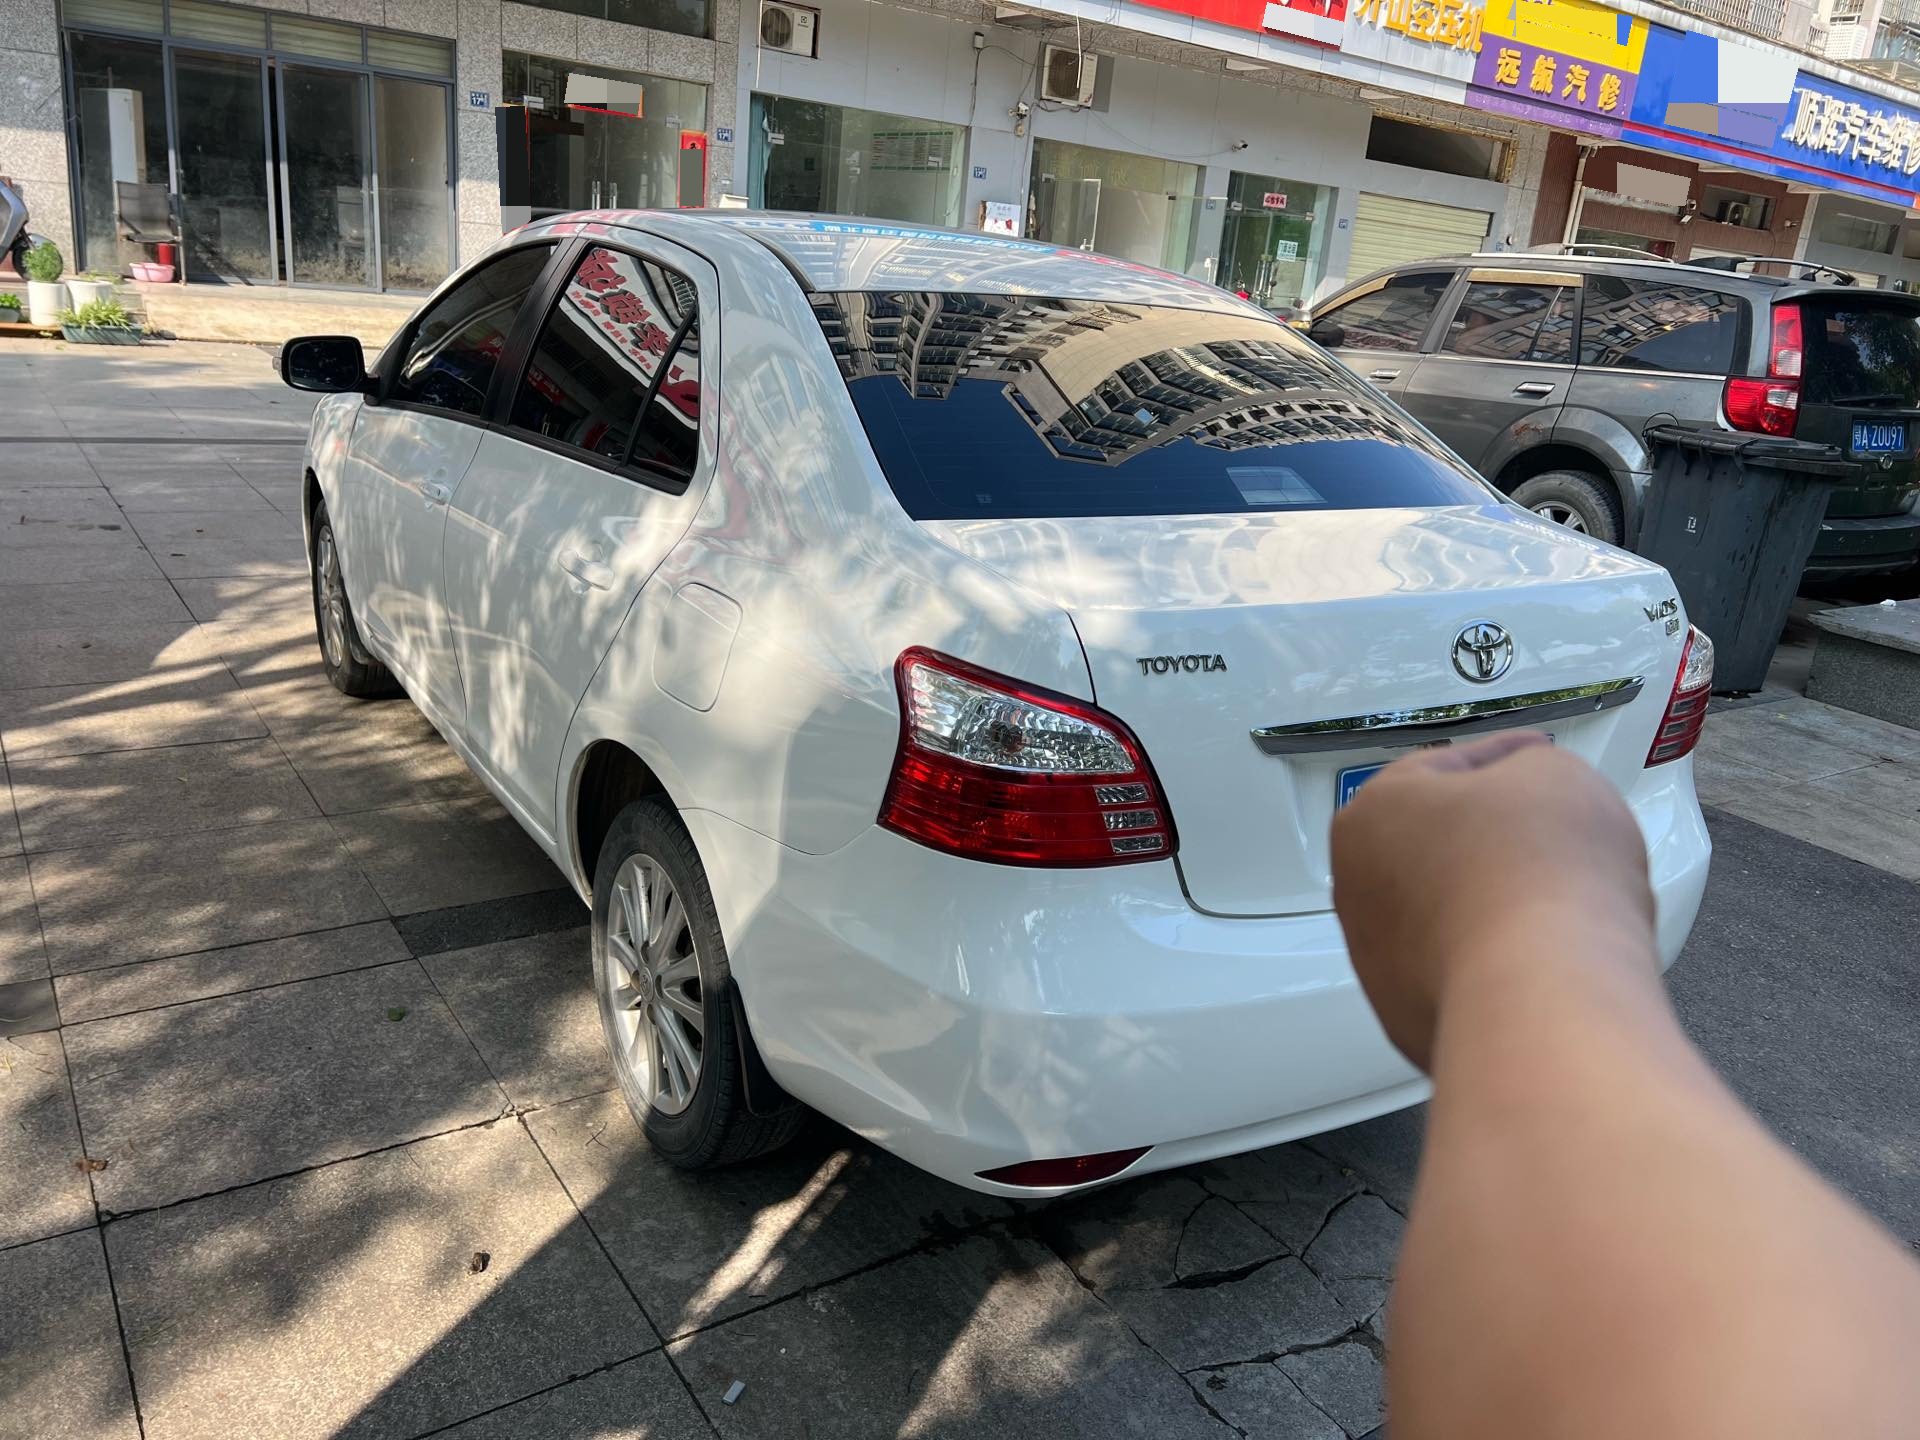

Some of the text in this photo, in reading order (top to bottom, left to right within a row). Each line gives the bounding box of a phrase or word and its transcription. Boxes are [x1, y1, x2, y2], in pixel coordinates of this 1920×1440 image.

[1495, 47, 1621, 111] 远航汽修
[1643, 598, 1677, 622] VIOS
[1136, 654, 1227, 676] TOYOTA
